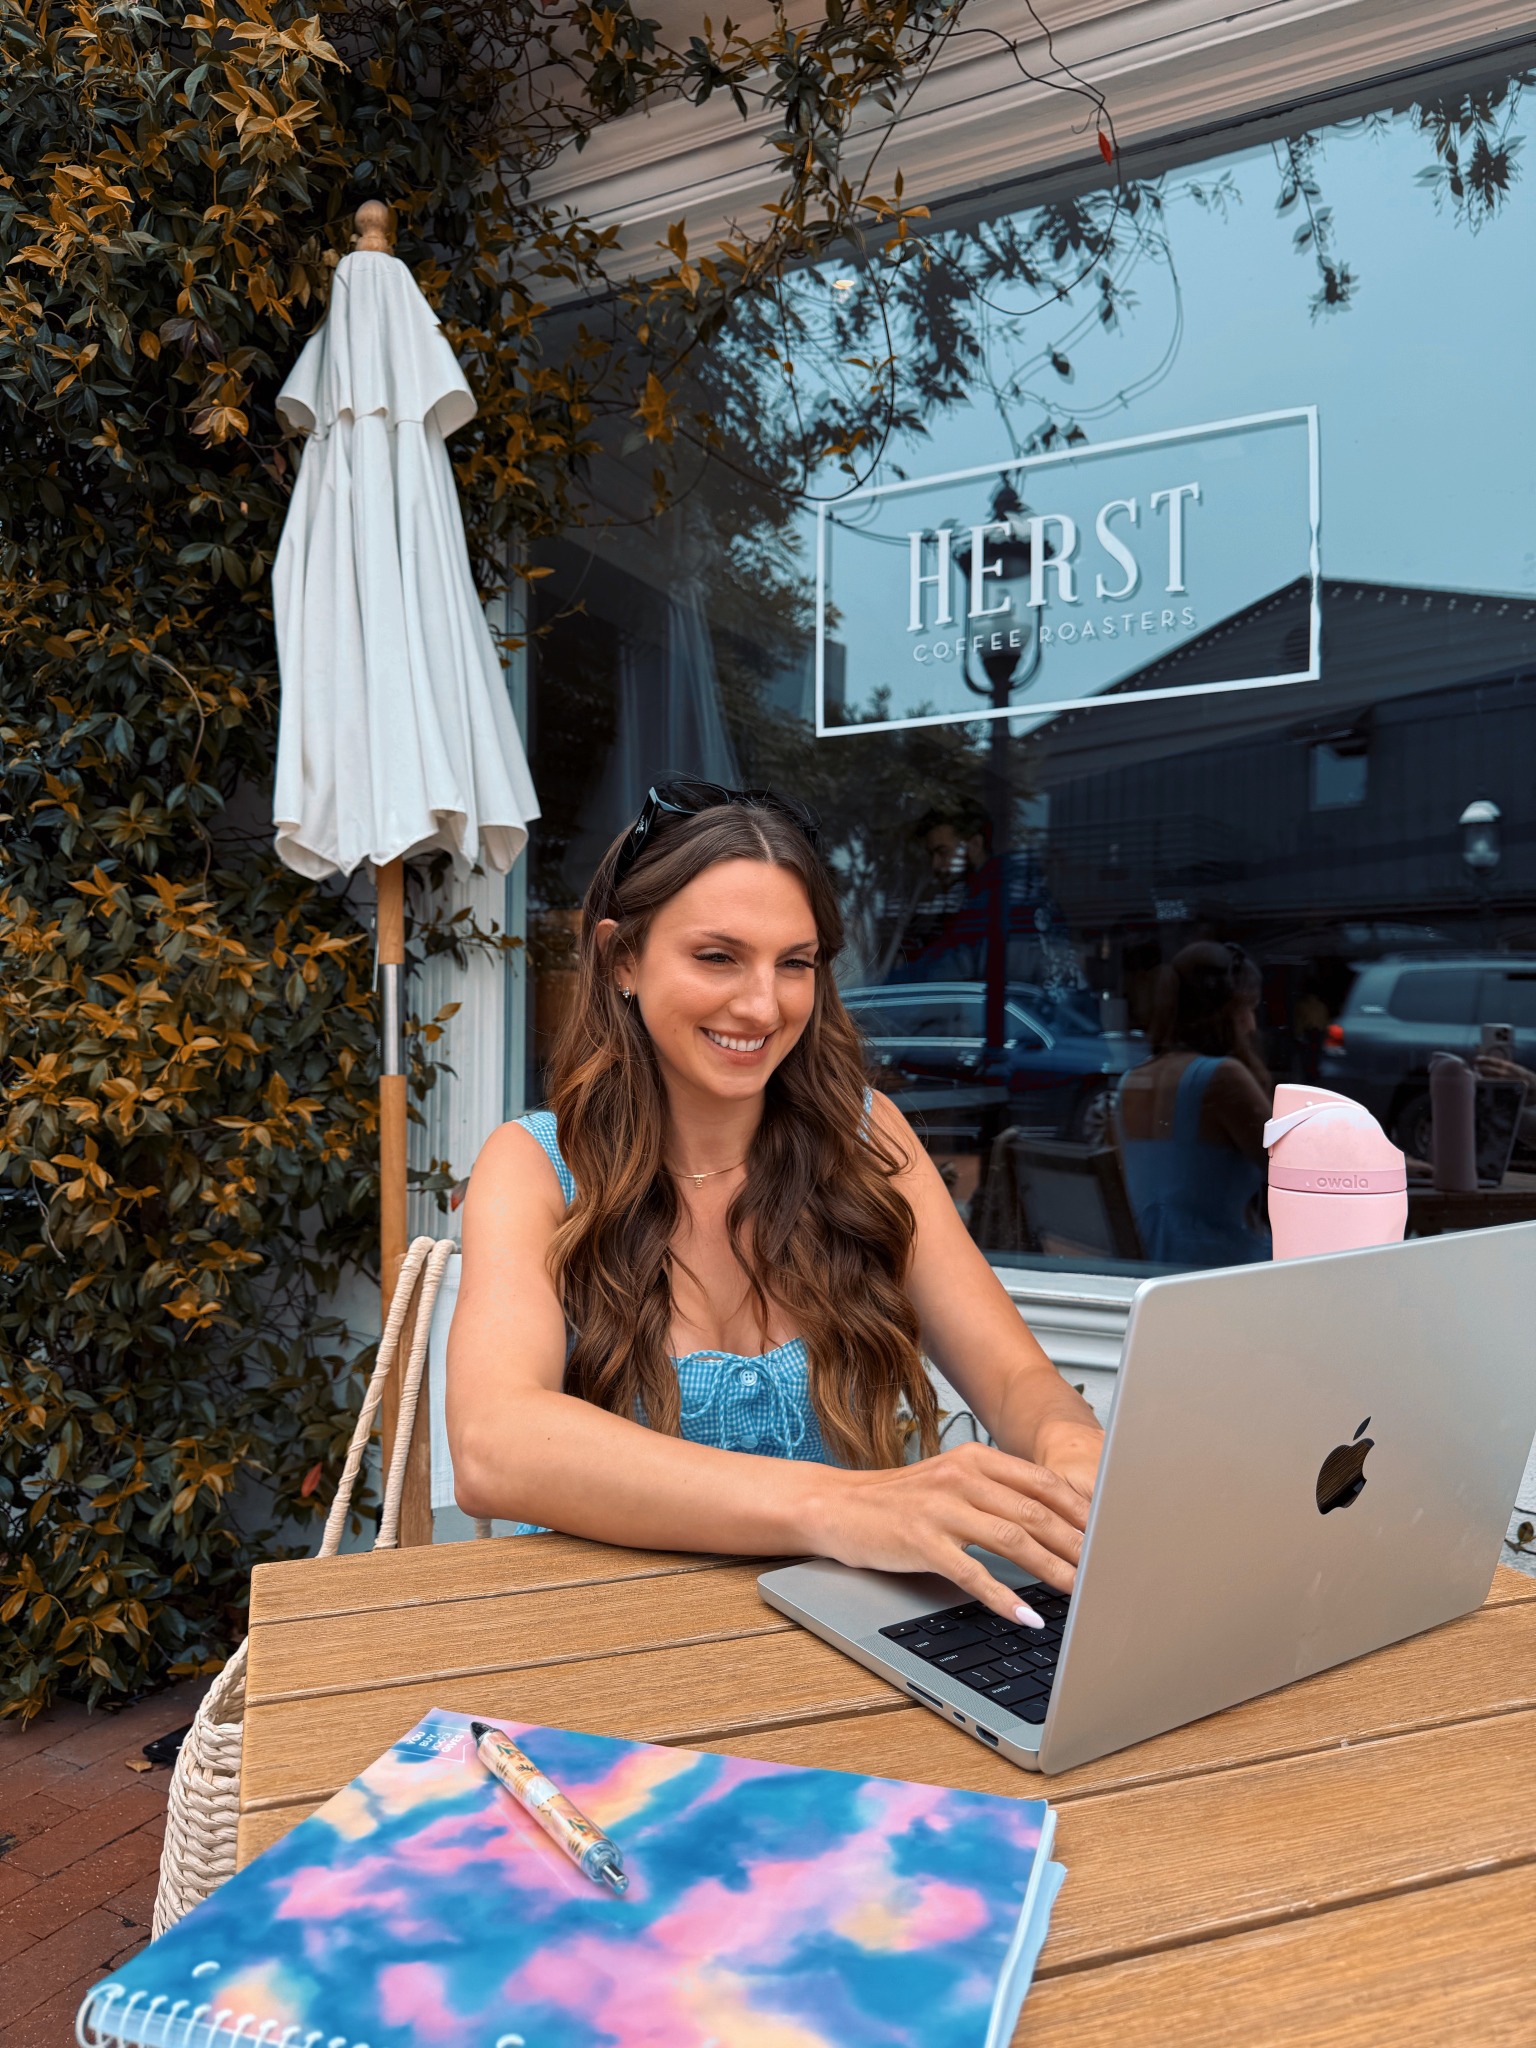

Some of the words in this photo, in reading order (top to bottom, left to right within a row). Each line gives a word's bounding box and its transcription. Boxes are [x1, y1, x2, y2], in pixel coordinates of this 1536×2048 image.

[906, 481, 1200, 632] HERST
[913, 628, 1022, 662] COFFEE
[1039, 606, 1195, 644] ROASTERS
[1316, 1174, 1369, 1189] owala
[406, 1732, 425, 1745] YOU
[418, 1733, 437, 1747] BUY
[441, 1734, 464, 1752] GIVES
